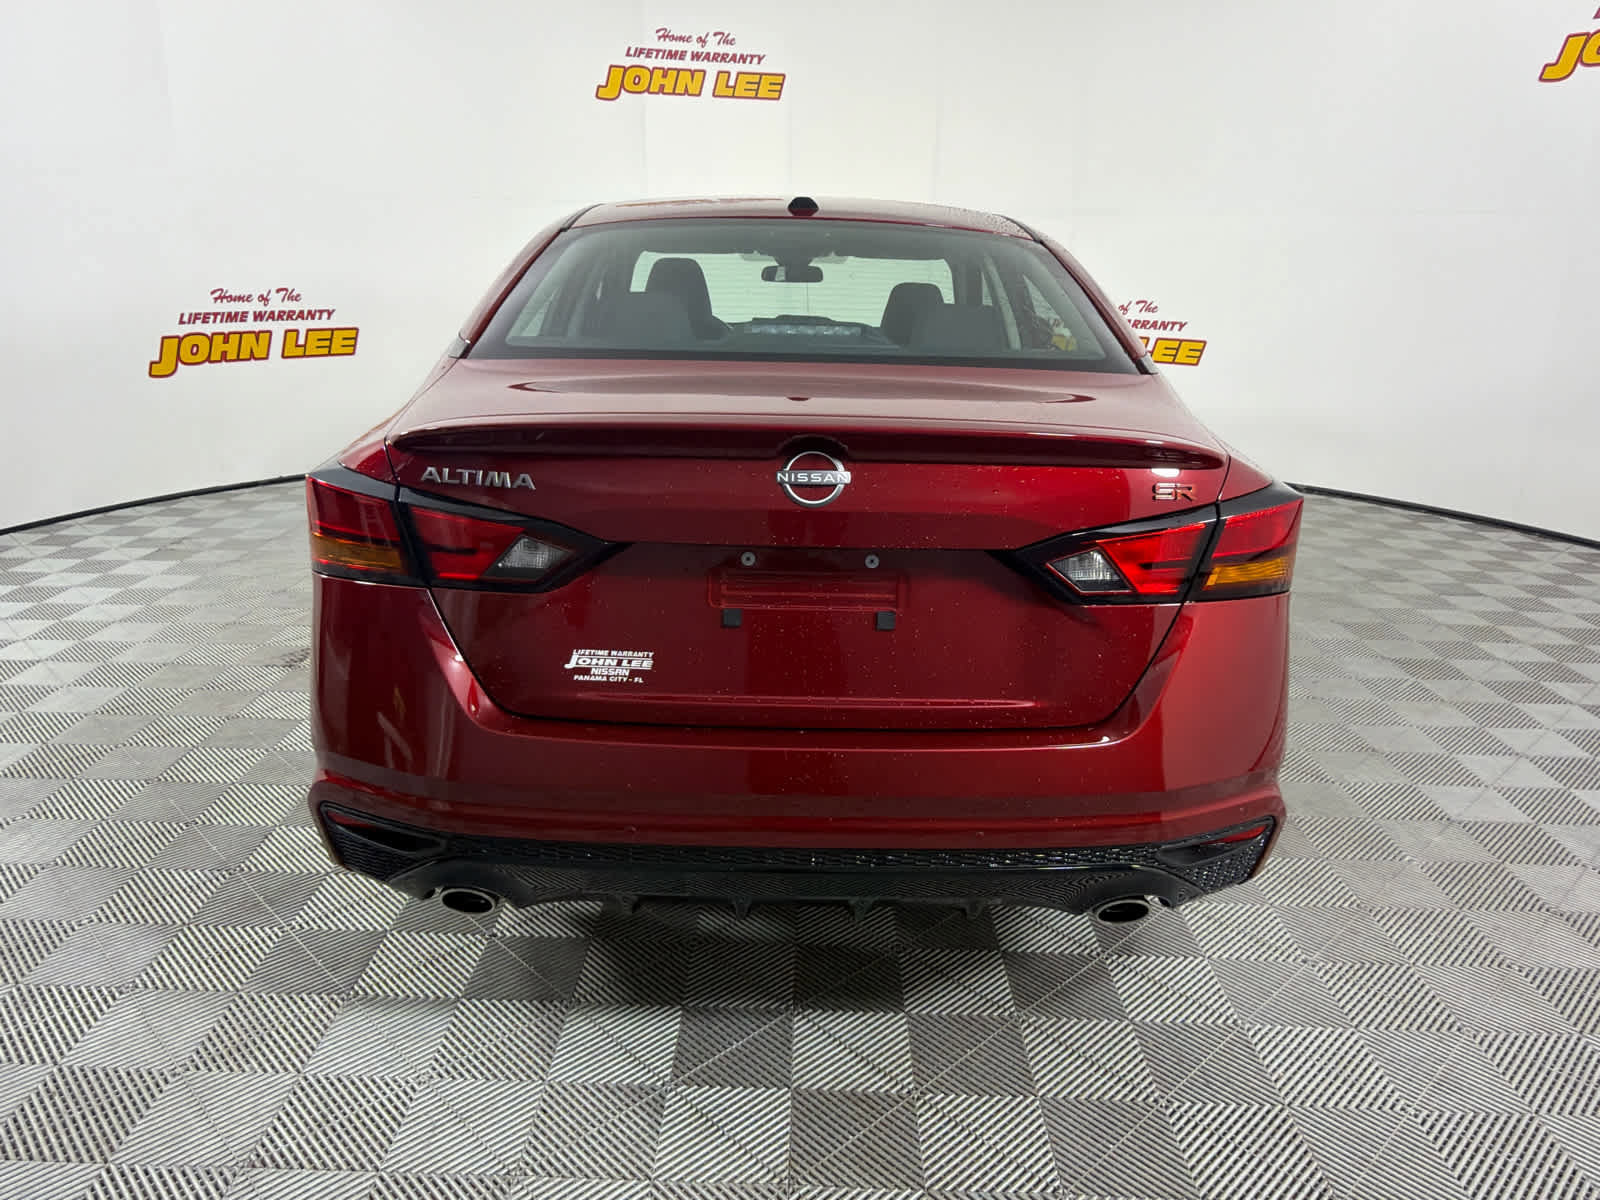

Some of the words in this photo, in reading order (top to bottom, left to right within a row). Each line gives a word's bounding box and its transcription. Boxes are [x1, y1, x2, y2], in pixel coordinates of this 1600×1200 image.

[655, 27, 693, 43] Home
[696, 32, 710, 48] of
[713, 31, 736, 46] The
[625, 46, 688, 61] LIFETIME
[690, 51, 766, 65] WARRANTY
[595, 64, 705, 100] JOHN
[712, 71, 785, 100] LEE
[210, 288, 254, 304] Home
[257, 289, 271, 307] of
[275, 287, 302, 303] The
[178, 310, 249, 325] LIFETIME
[252, 308, 336, 323] WARRANTY
[1118, 301, 1132, 315] of
[1135, 299, 1159, 314] The
[1127, 319, 1187, 331] RRANTY
[149, 330, 272, 378] JOHN
[281, 327, 359, 359] LEE
[421, 466, 536, 490] ALTIMA
[777, 472, 848, 483] NISSAN
[1151, 482, 1197, 502] SR
[564, 654, 618, 668] JOHN
[621, 659, 654, 667] LEE
[591, 668, 630, 676] NISSAN
